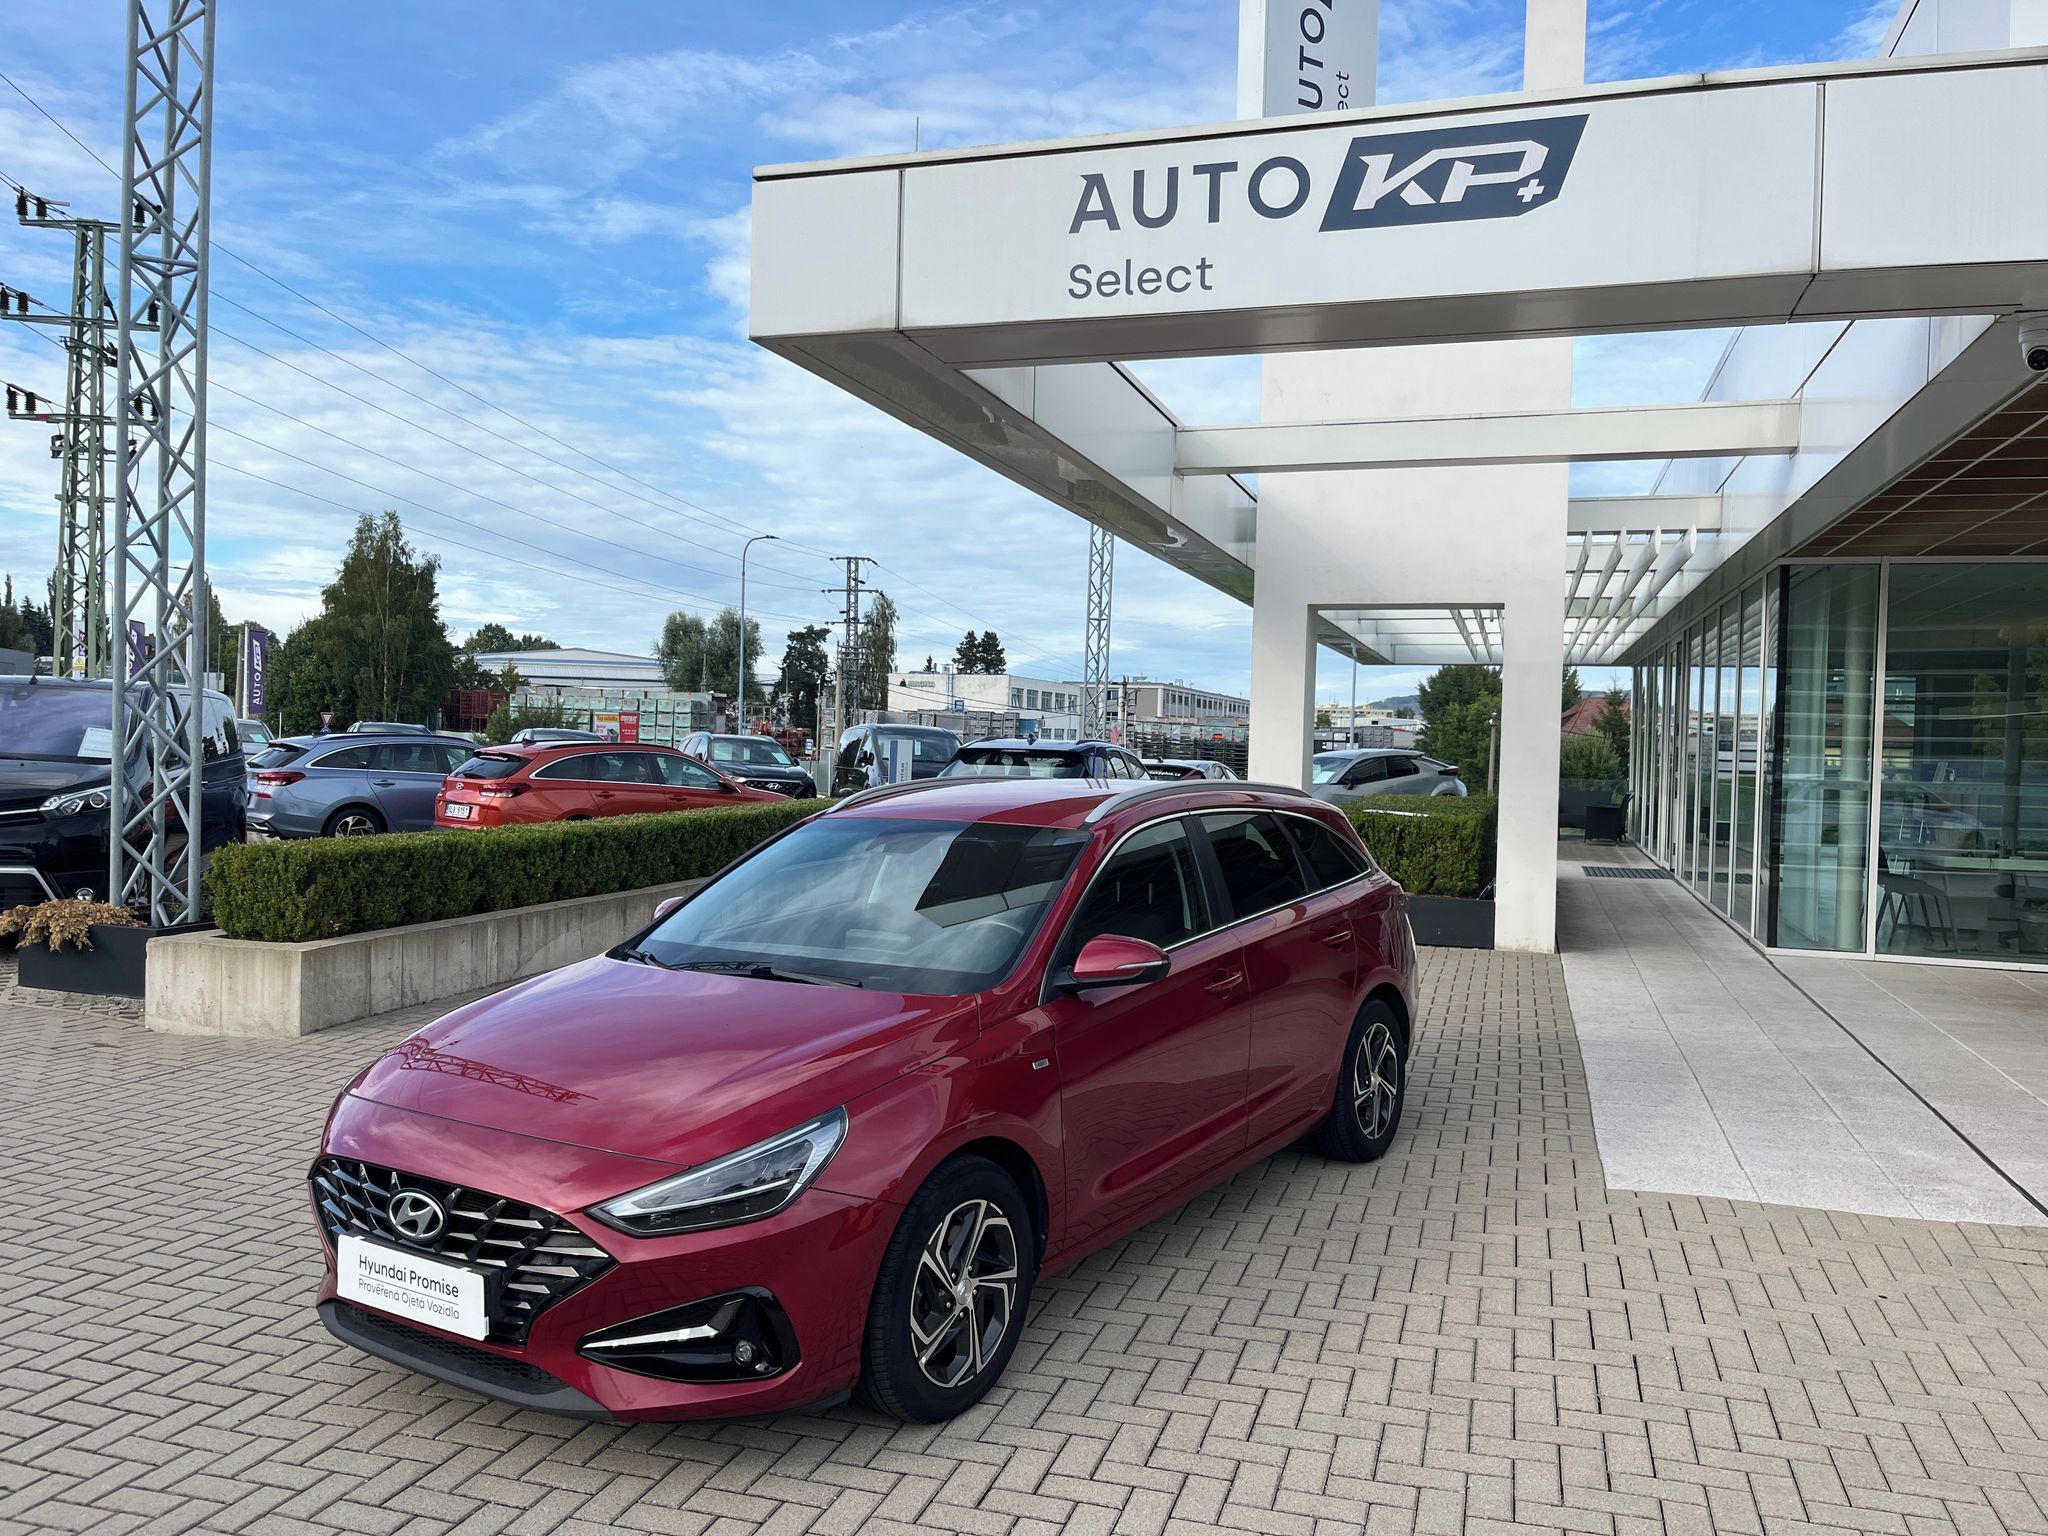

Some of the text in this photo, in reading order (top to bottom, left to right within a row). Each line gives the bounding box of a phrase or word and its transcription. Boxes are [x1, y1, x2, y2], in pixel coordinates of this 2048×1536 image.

[1298, 8, 1325, 110] UTO
[1068, 156, 1311, 234] AUTO
[1068, 257, 1214, 299] Select
[253, 672, 261, 705] AUTO
[358, 1278, 400, 1301] Prověřená
[401, 1291, 425, 1309] Ojetá
[359, 1254, 460, 1298] Hyundai Promise
